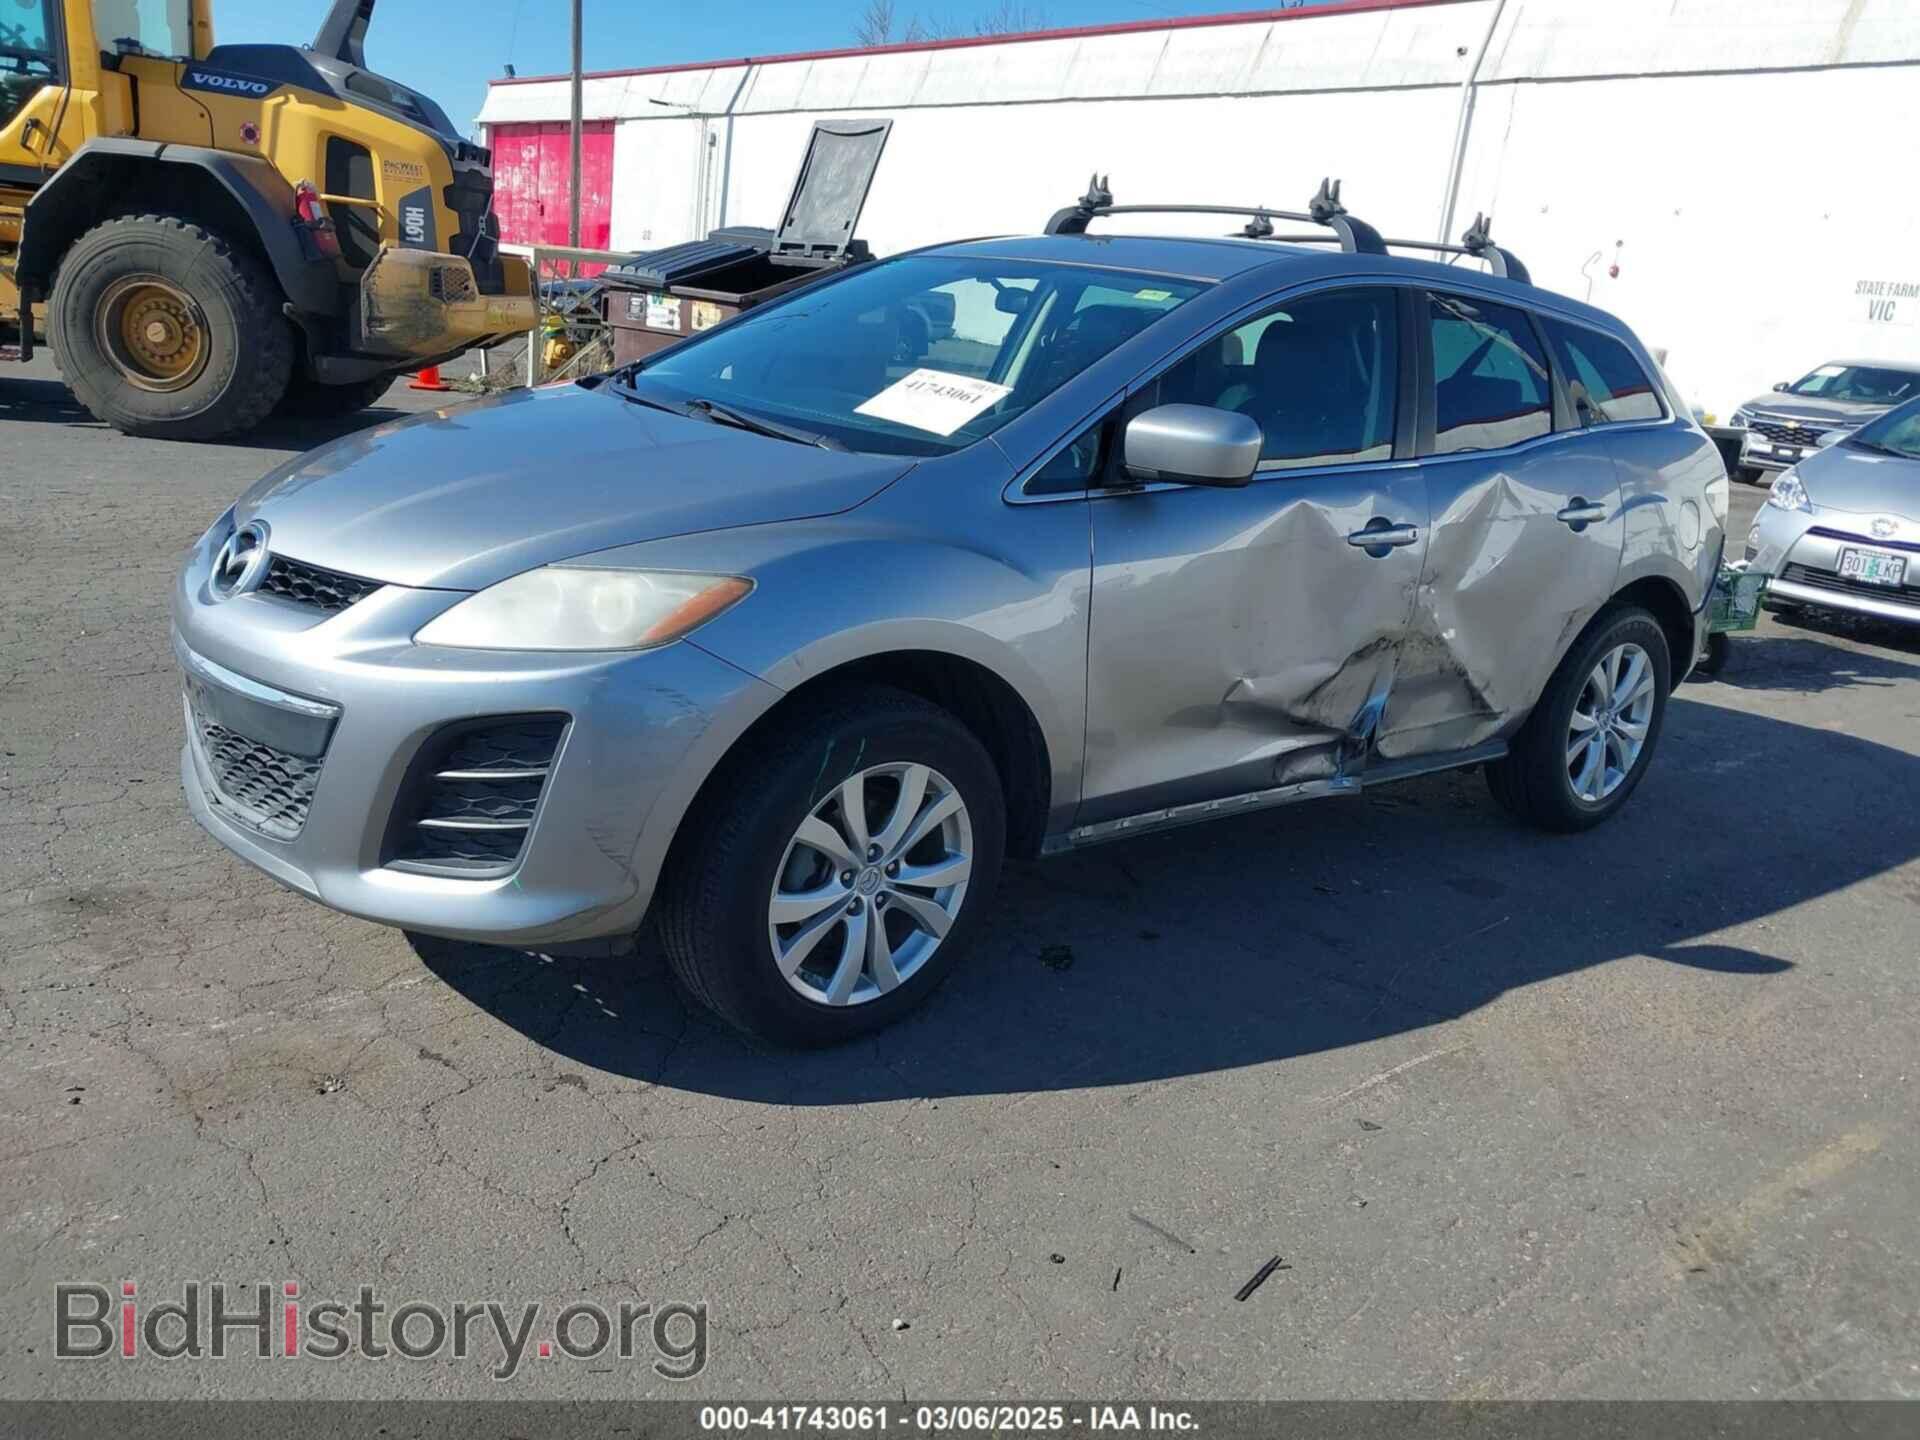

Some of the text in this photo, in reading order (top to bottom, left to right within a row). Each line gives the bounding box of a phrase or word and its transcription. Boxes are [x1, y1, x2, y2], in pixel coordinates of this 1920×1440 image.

[192, 72, 269, 93] VOLVO
[405, 206, 425, 242] L90H
[1855, 280, 1920, 297] STATE FARM
[1869, 299, 1896, 321] VIC
[906, 380, 983, 404] 41743061
[1844, 556, 1903, 580] 301 LKP
